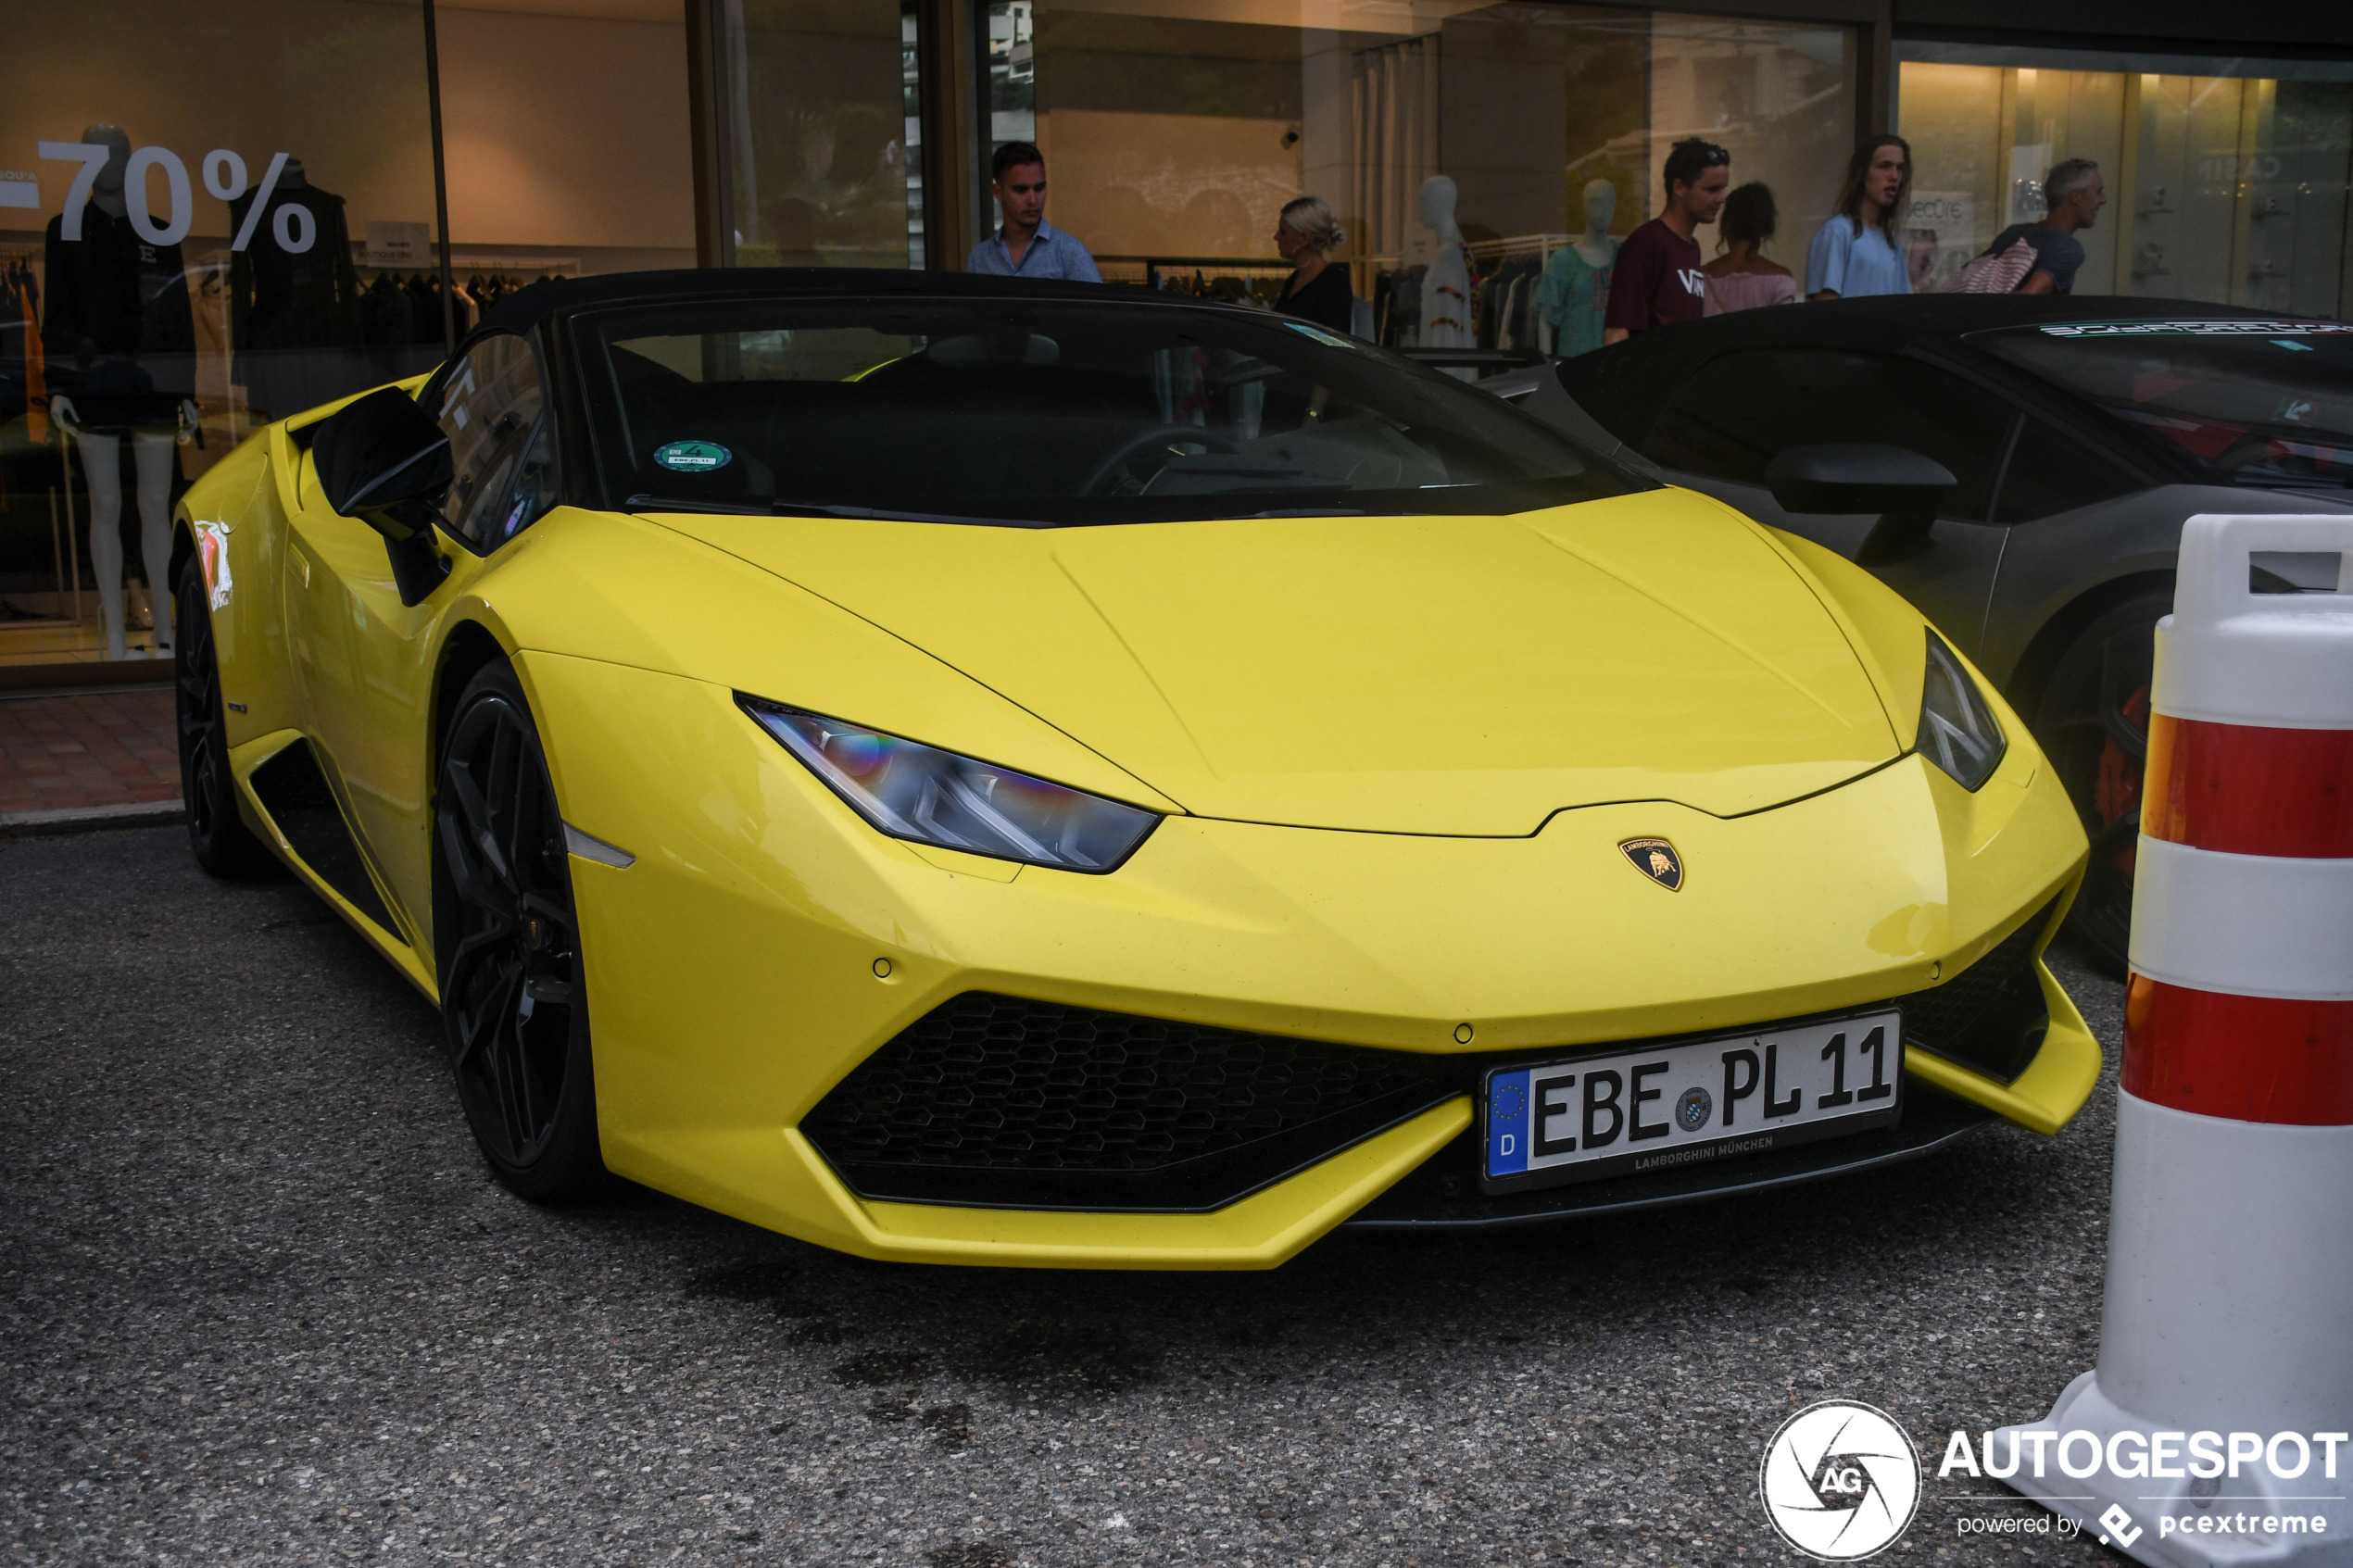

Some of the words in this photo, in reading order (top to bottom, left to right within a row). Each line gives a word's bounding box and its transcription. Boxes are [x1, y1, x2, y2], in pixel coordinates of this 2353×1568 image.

[139, 245, 157, 263] E
[685, 445, 703, 457] 4
[1624, 841, 1669, 853] LAMBORGHINI
[1533, 1061, 1669, 1157] EBE
[1722, 1044, 1802, 1126] PL
[1818, 1026, 1892, 1109] 11
[1501, 1134, 1516, 1156] D
[1635, 1146, 1716, 1171] LAMBORGHINI
[1718, 1135, 1774, 1155] MÜNCHEN
